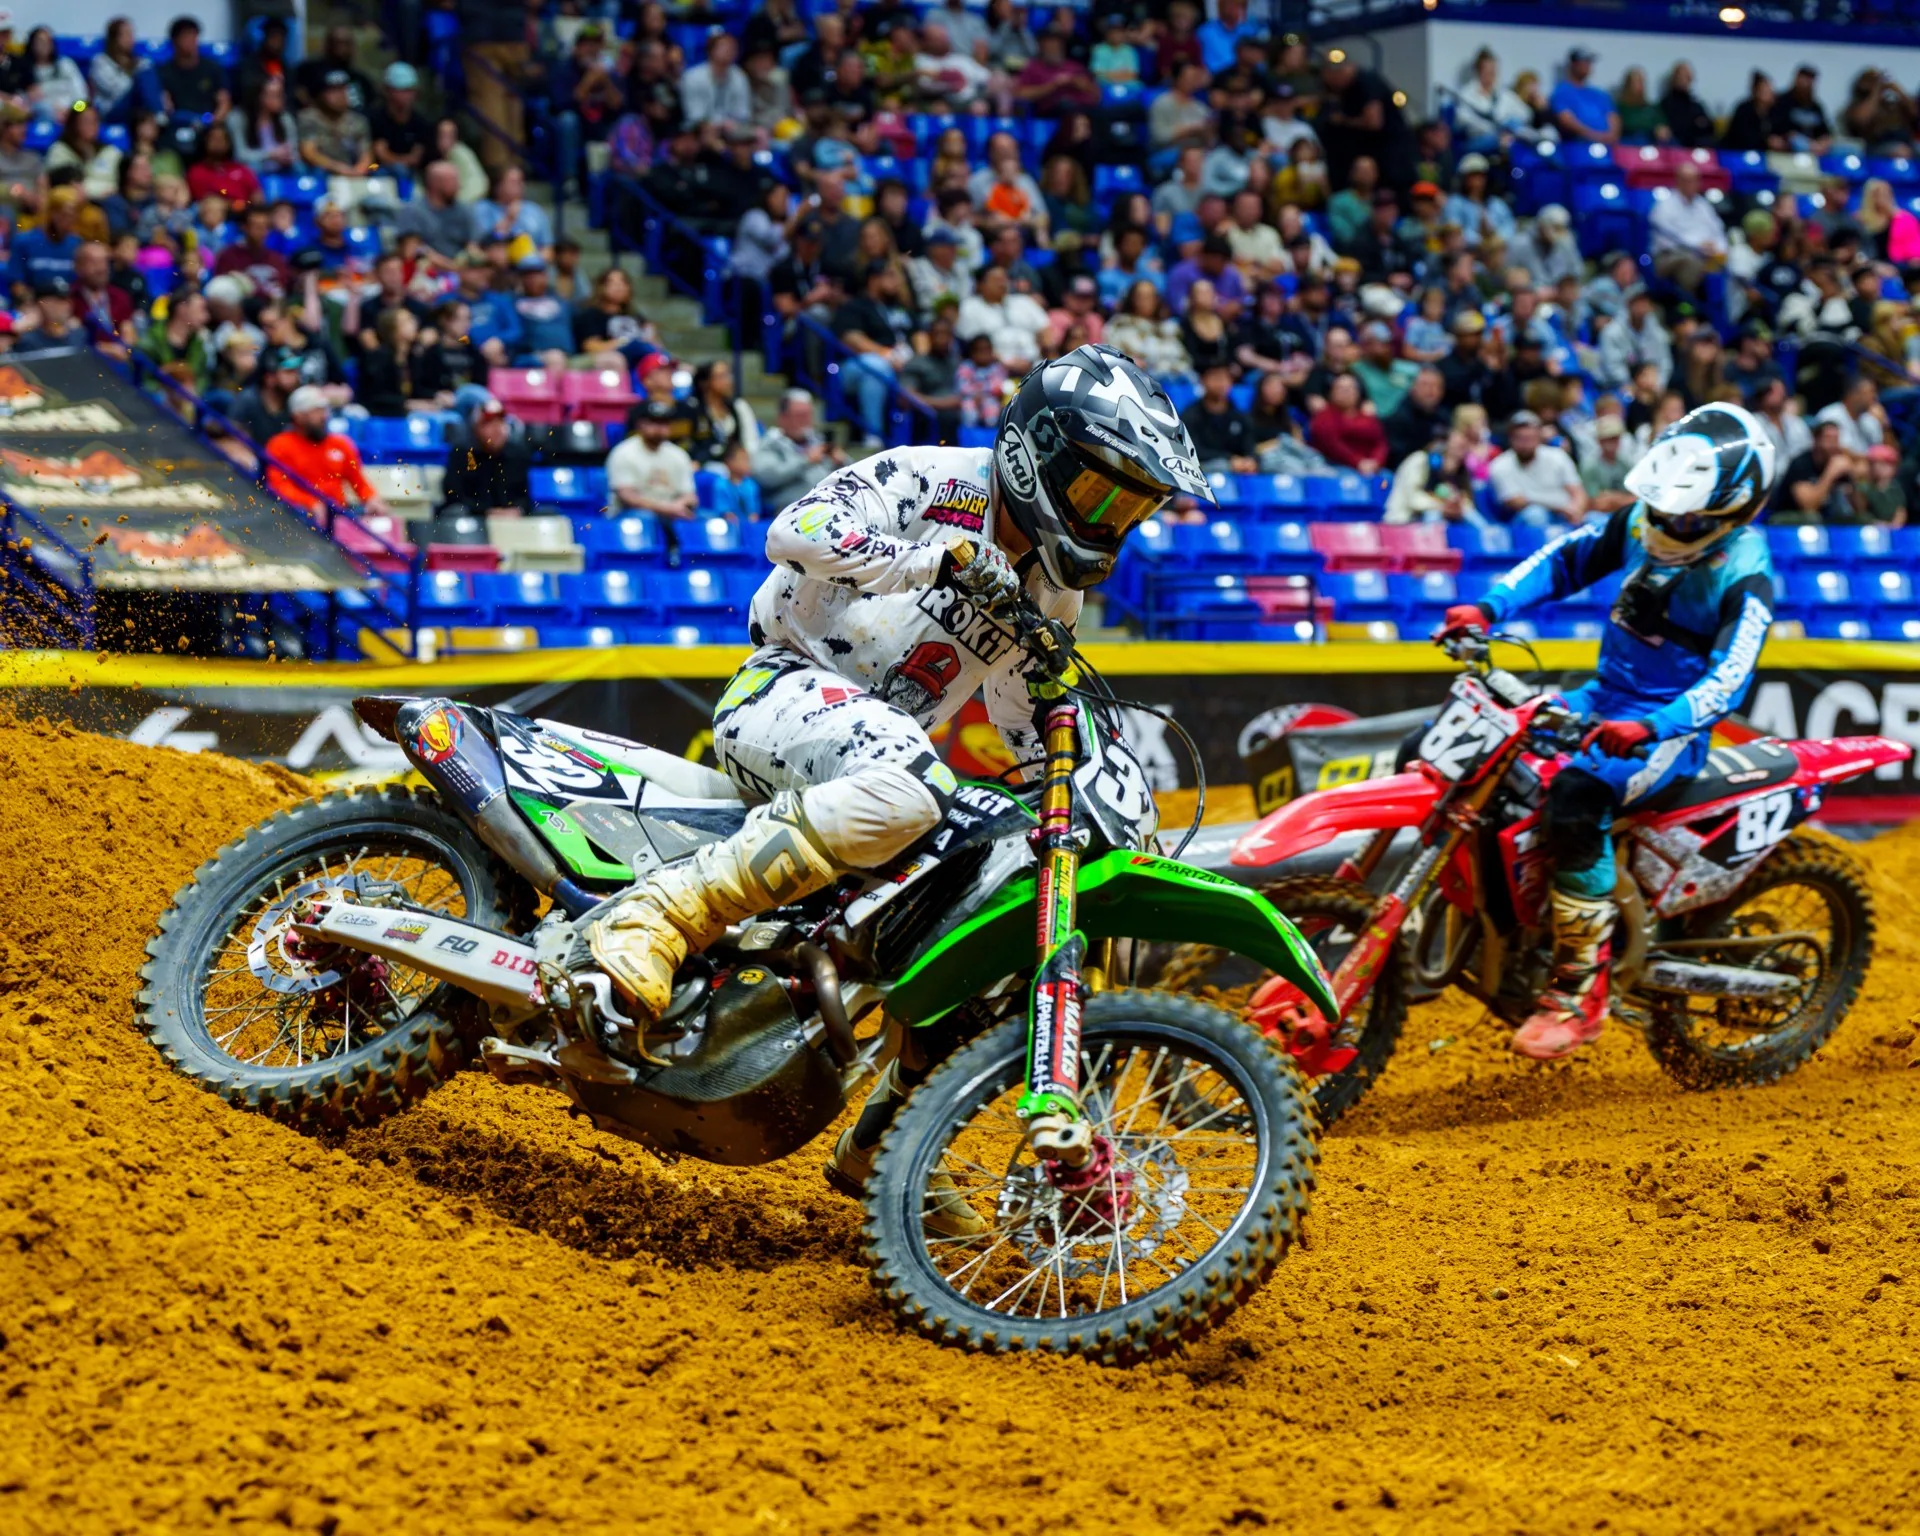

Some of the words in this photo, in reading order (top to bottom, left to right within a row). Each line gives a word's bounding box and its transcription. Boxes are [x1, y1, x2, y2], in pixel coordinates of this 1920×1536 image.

[1004, 440, 1036, 490] Arai
[922, 508, 984, 534] POWER
[932, 483, 988, 517] BLASTER
[1419, 699, 1505, 782] 82
[1735, 792, 1793, 852] 82
[438, 934, 480, 954] FLO
[1033, 1003, 1052, 1077] PARTZILLA
[1061, 998, 1081, 1082] MAXXIS
